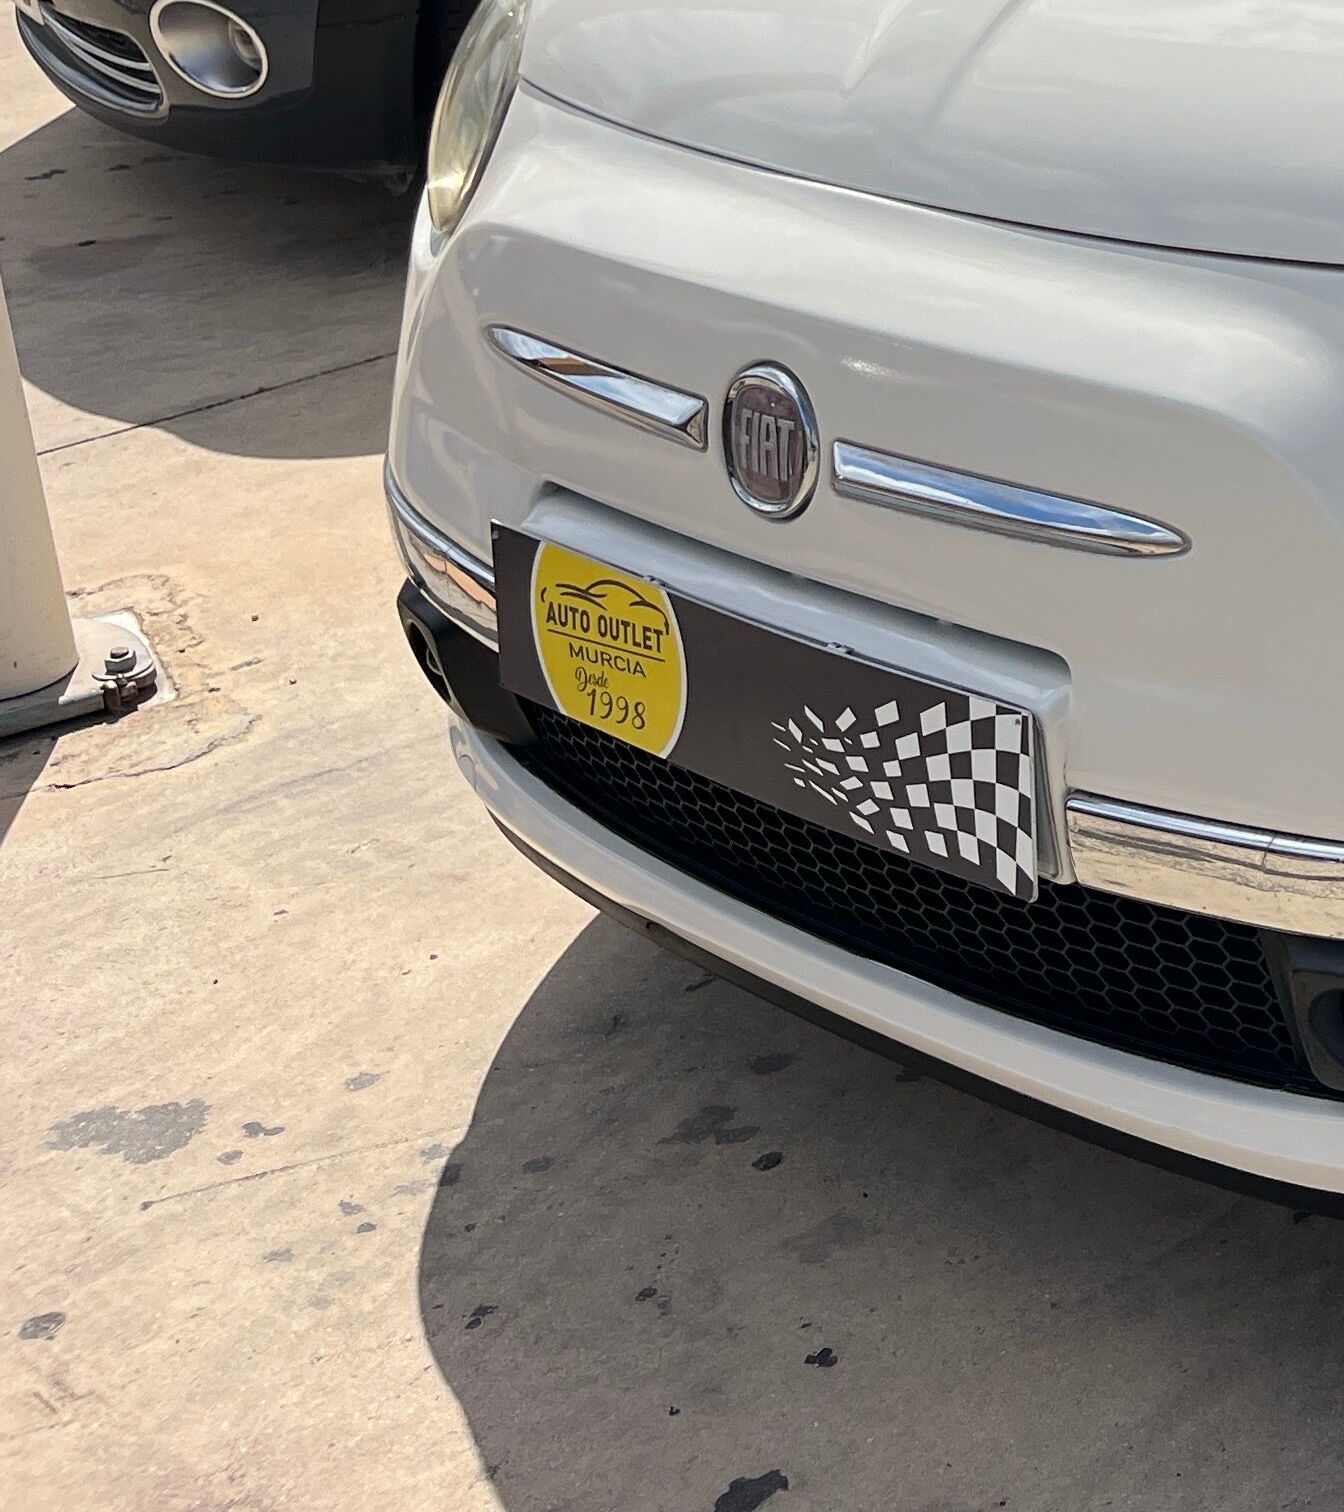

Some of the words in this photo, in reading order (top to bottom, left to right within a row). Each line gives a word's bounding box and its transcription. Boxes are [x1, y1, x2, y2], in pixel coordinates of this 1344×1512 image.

[739, 408, 796, 482] FIAT
[546, 601, 591, 634] AUTO
[597, 614, 663, 653] OUTLET
[569, 642, 647, 678] MURCIA
[575, 666, 609, 692] Desde
[586, 689, 646, 730] 1998
